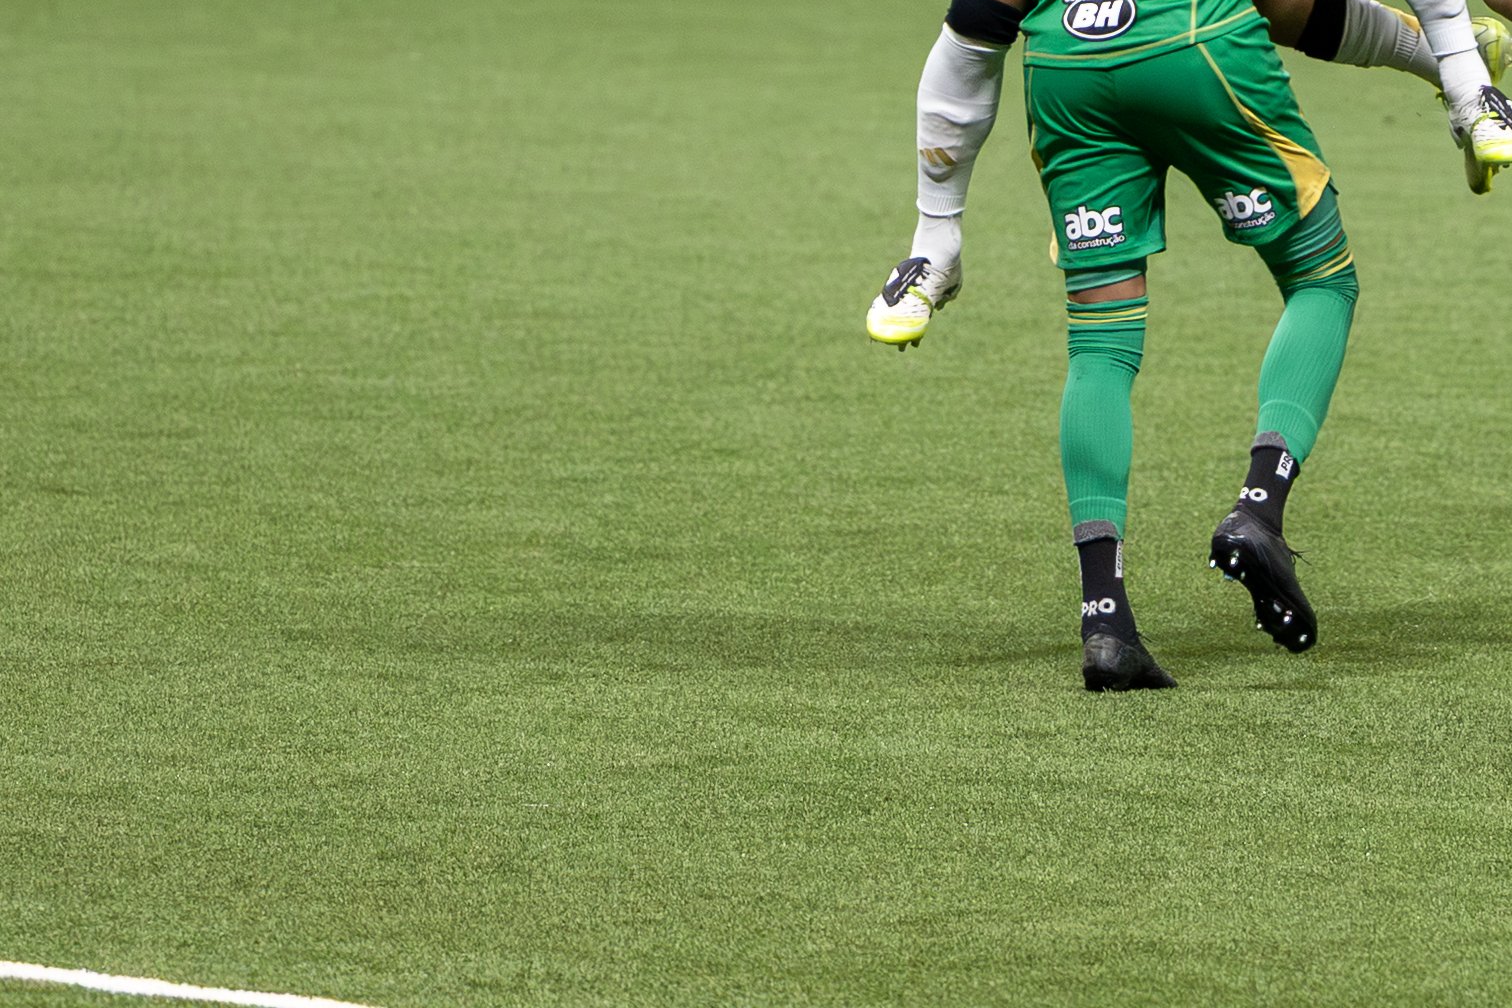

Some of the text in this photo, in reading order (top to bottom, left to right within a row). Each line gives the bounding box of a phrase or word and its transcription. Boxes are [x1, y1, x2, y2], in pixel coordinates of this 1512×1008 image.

[1072, 0, 1124, 29] BH
[1214, 187, 1272, 220] abc
[1064, 206, 1123, 240] abc
[1082, 598, 1117, 617] PRO
